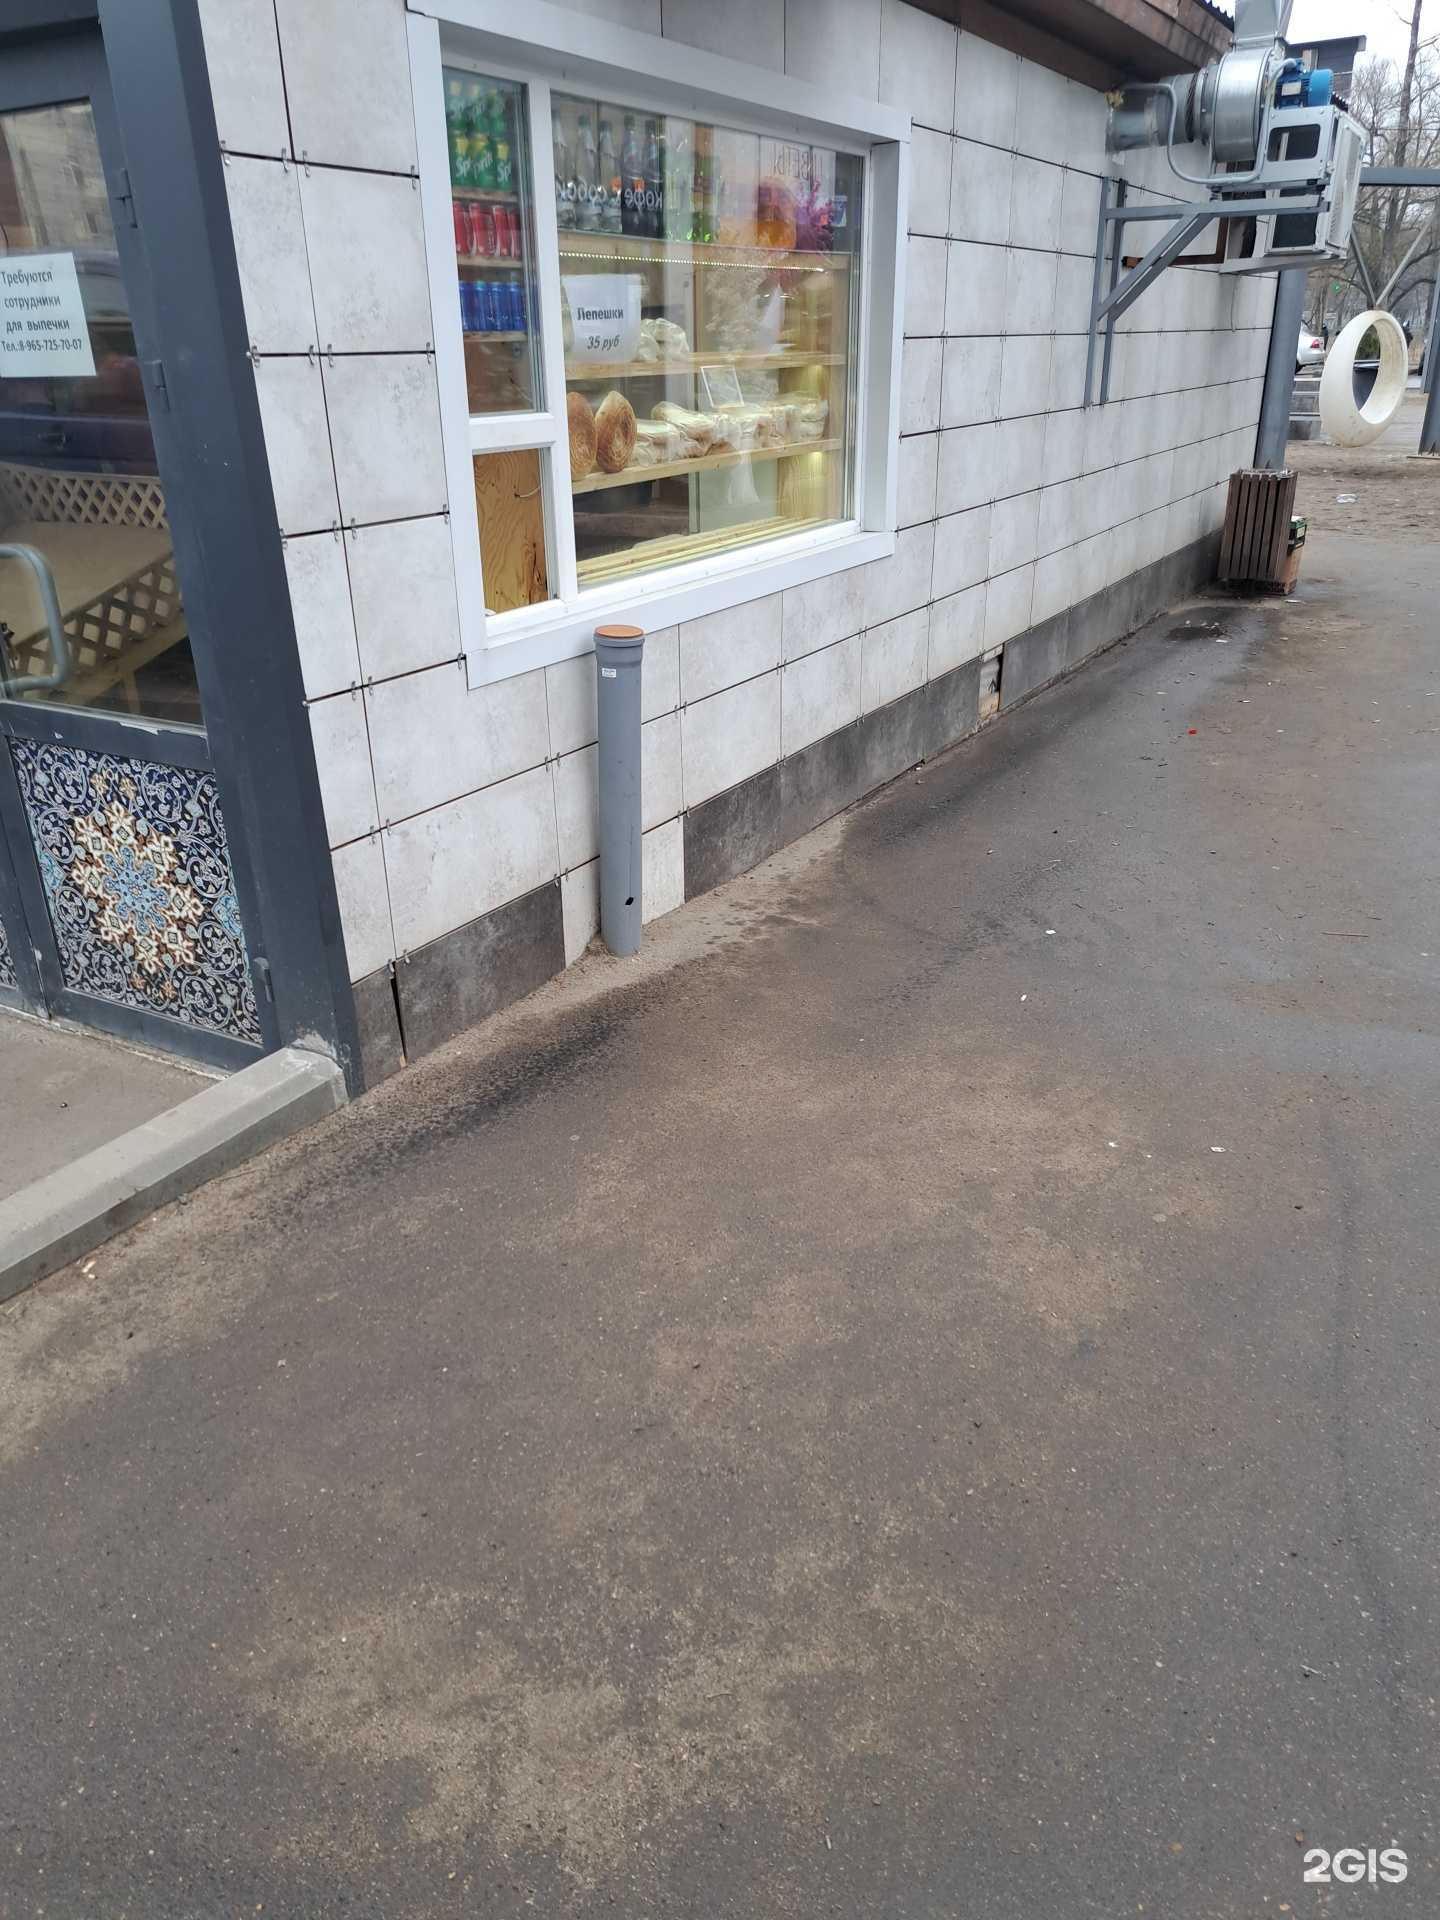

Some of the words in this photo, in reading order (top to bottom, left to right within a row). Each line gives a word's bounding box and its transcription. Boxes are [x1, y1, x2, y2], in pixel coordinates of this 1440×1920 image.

[1, 269, 53, 287] Требуются
[4, 295, 61, 310] сотрудники
[6, 319, 22, 334] для
[27, 318, 70, 332] выпечки
[587, 336, 600, 350] 35
[602, 334, 621, 351] руб
